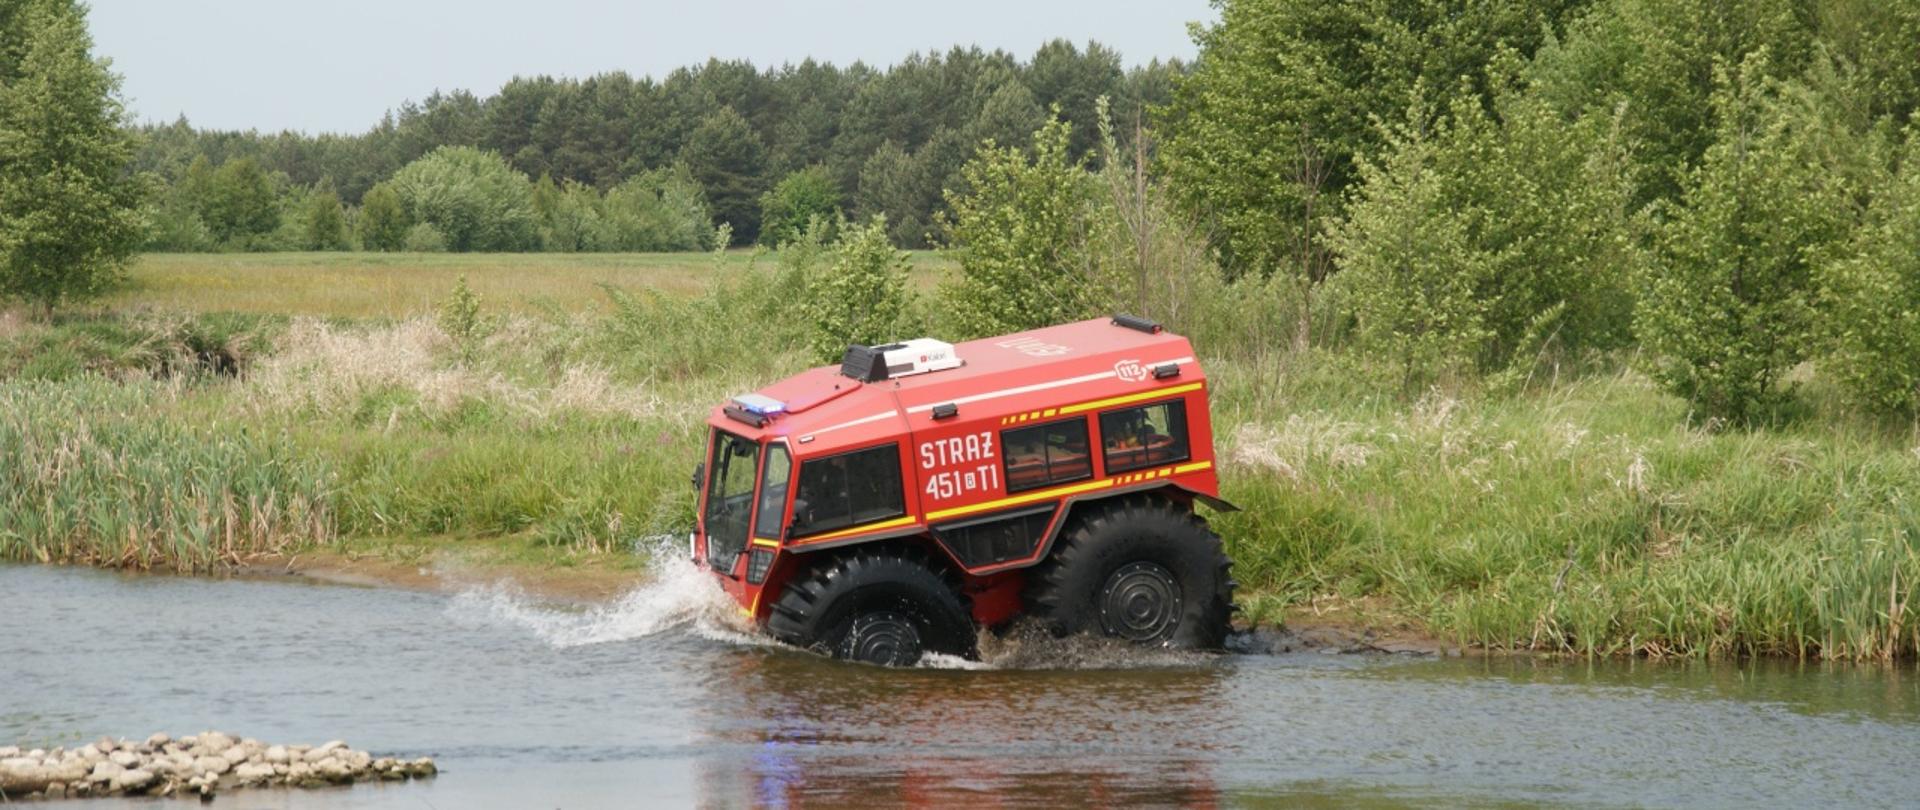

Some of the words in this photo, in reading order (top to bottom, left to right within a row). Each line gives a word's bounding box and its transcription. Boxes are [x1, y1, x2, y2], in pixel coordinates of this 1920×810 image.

[1120, 364, 1141, 377] 112
[925, 470, 962, 500] 451
[977, 464, 998, 491] T1
